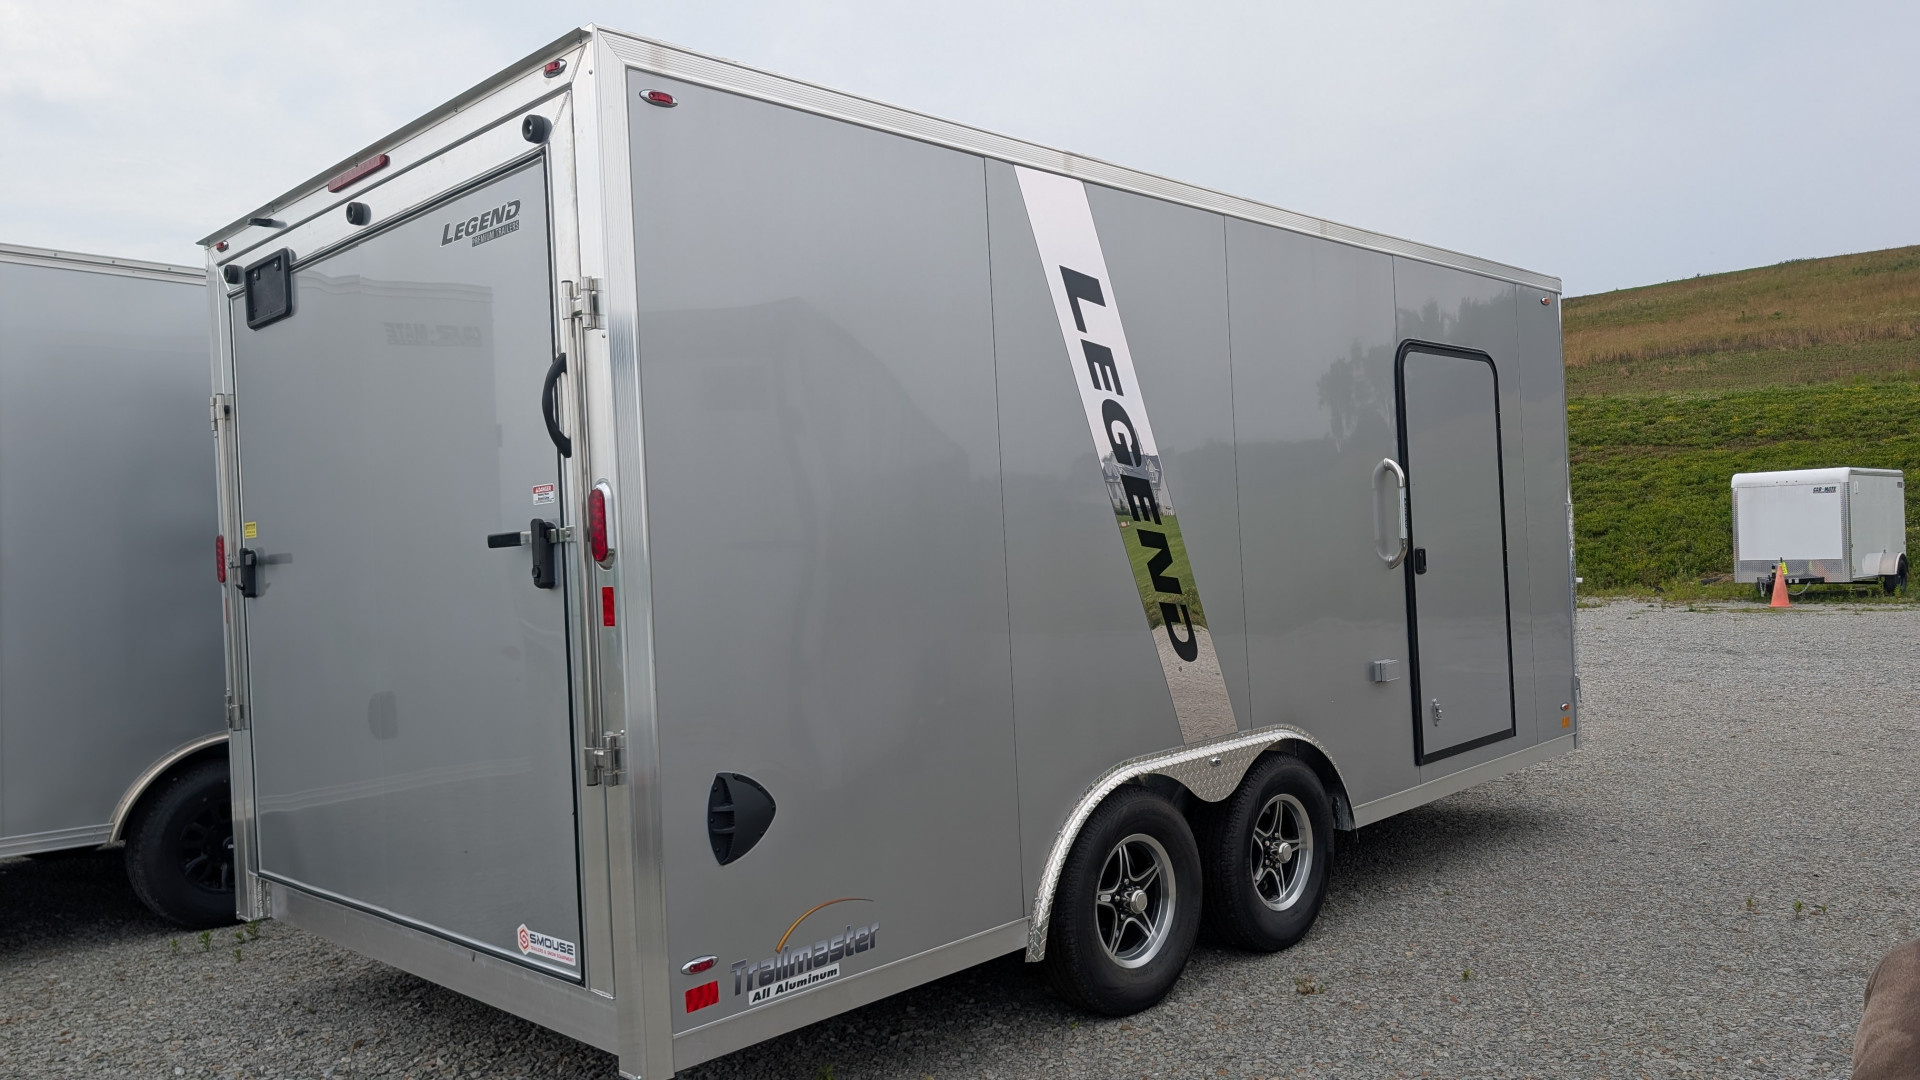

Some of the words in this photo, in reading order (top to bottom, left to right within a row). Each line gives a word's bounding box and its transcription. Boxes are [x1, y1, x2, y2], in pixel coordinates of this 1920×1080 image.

[441, 200, 520, 246] LEGEND
[472, 229, 495, 247] PREMIUM
[496, 220, 519, 238] TRAILERS
[1059, 264, 1198, 662] LEGEND
[530, 934, 573, 955] SMOUSE
[731, 922, 879, 996] Trailmaster
[752, 987, 771, 1003] All
[775, 967, 838, 995] Aluminum
